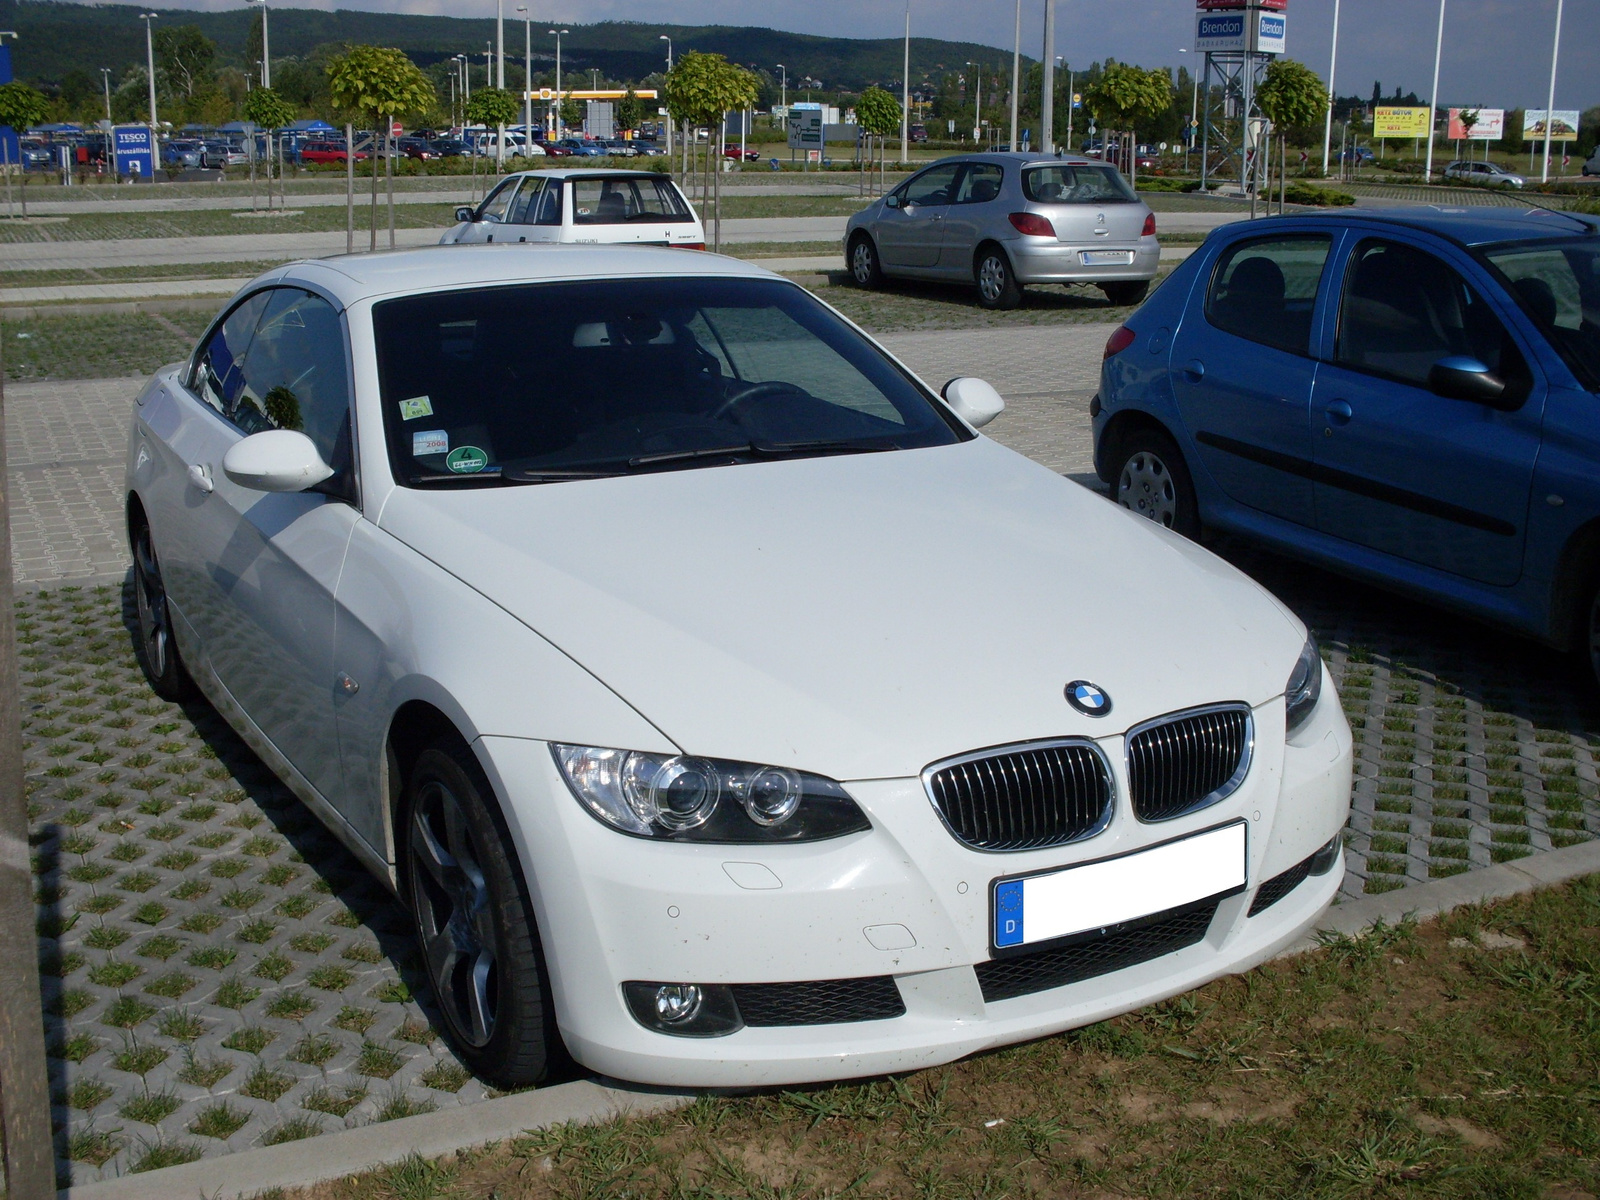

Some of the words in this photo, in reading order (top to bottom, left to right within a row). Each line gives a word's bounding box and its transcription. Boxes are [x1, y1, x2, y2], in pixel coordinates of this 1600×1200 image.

[1202, 20, 1240, 34] Brendon
[1261, 20, 1283, 35] Brendon
[665, 230, 671, 238] H
[461, 448, 472, 460] 4
[1005, 919, 1015, 934] D
